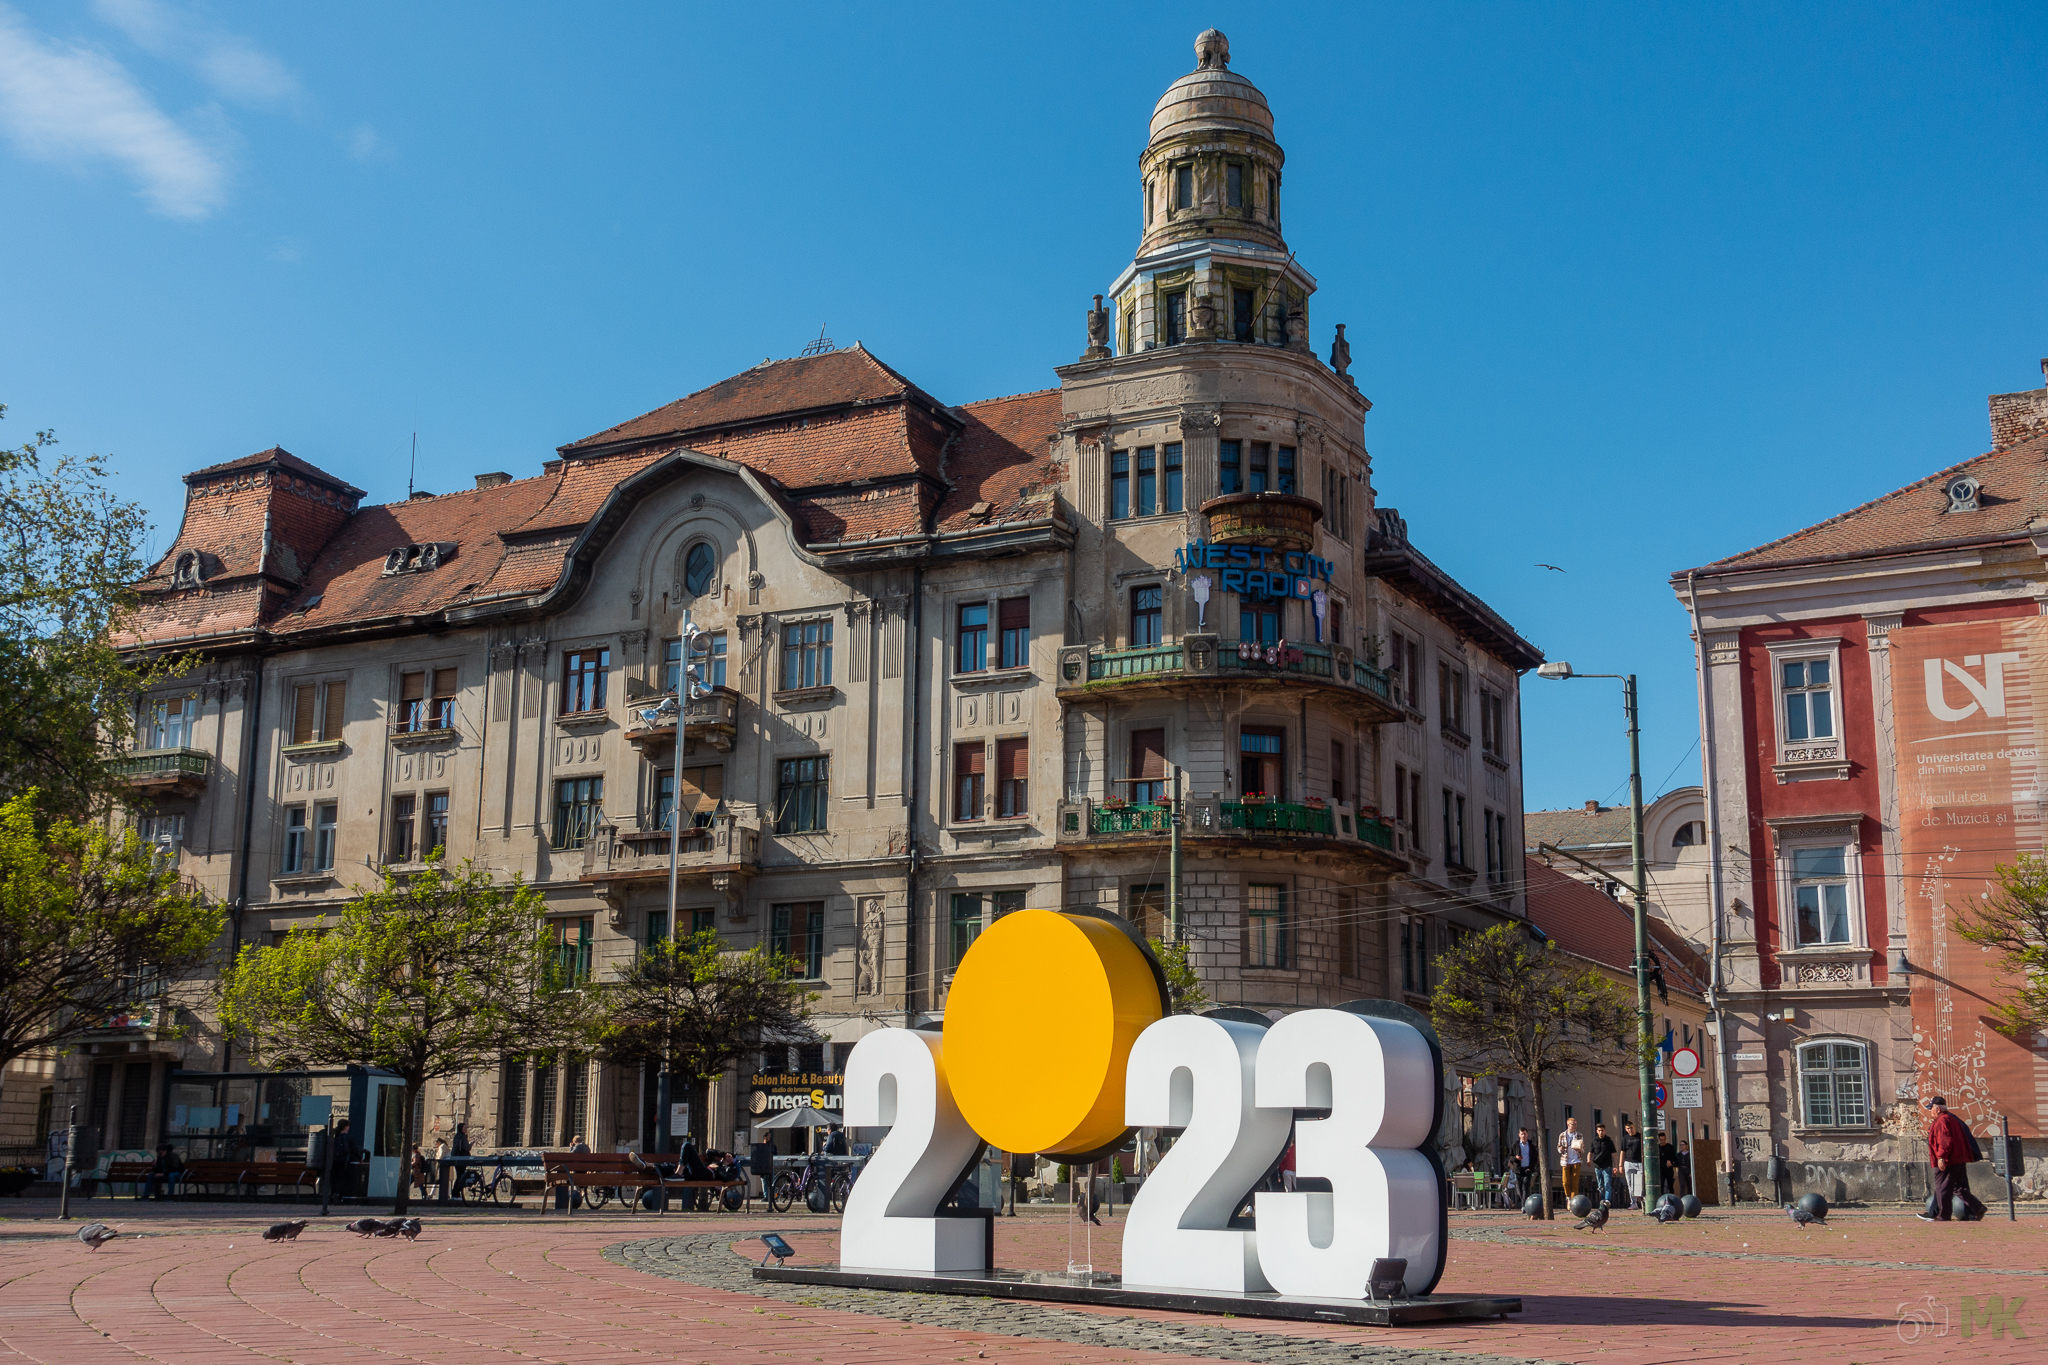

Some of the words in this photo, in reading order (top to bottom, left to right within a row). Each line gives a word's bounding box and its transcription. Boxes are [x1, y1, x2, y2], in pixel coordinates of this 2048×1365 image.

[1175, 538, 1273, 574] WEST
[1284, 551, 1334, 583] CITY
[1222, 569, 1311, 600] RADIO
[1916, 751, 1994, 764] Universitatea
[1996, 749, 2011, 759] de
[2013, 748, 2040, 757] Vest
[1918, 765, 1935, 775] din
[1920, 791, 1987, 805] Facultatea
[1921, 813, 1940, 826] de
[1946, 811, 1990, 825] Muzică
[752, 1074, 778, 1086] Salon
[780, 1073, 800, 1085] Hair
[801, 1073, 808, 1084] &
[810, 1073, 844, 1086] Beauty
